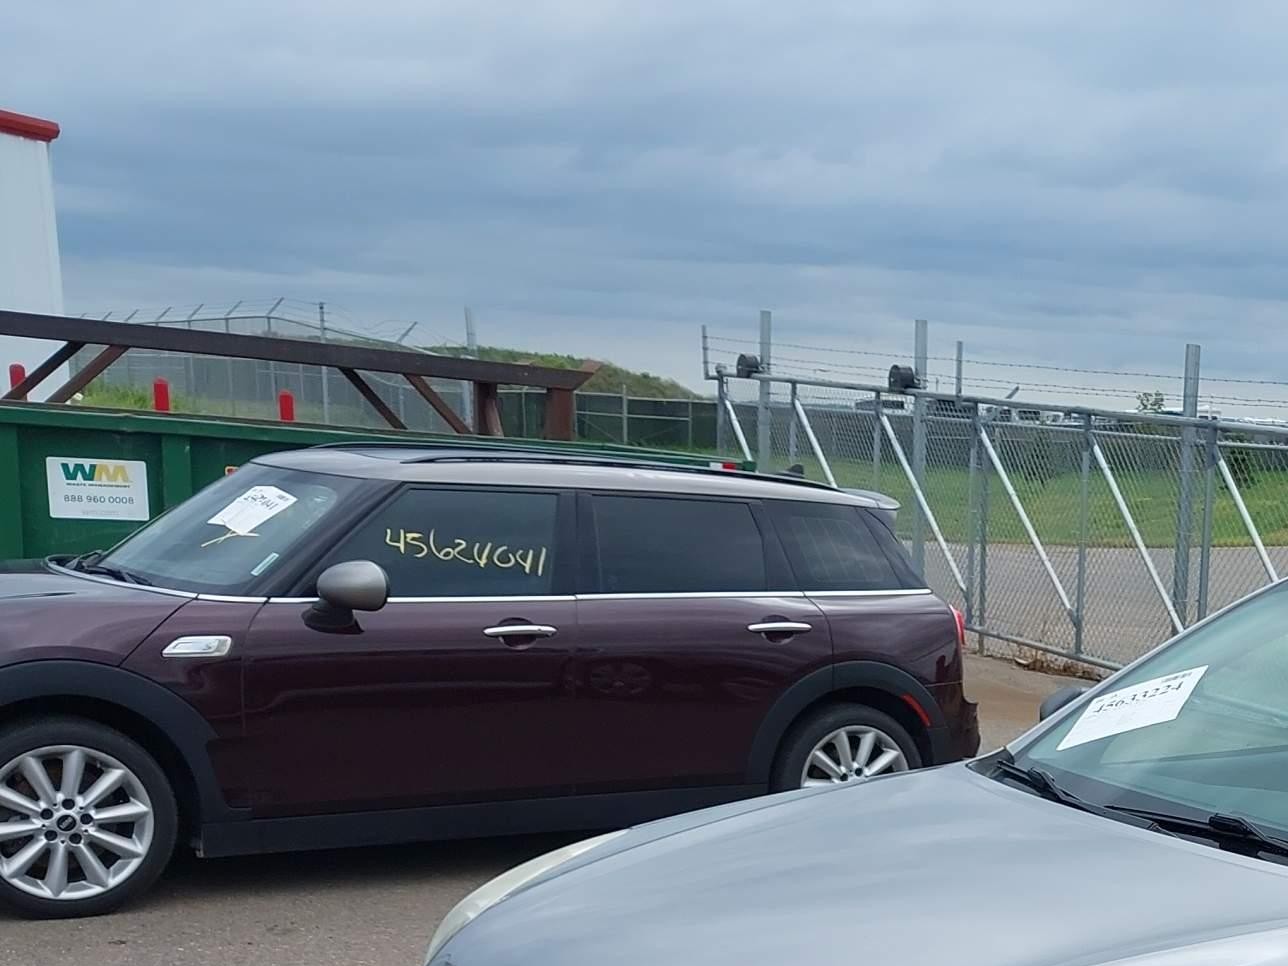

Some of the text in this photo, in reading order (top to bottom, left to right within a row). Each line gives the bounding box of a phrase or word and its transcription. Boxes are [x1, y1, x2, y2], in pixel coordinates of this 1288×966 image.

[61, 462, 129, 483] WM
[63, 494, 135, 505] 888 960 0008
[385, 528, 547, 577] 45624041
